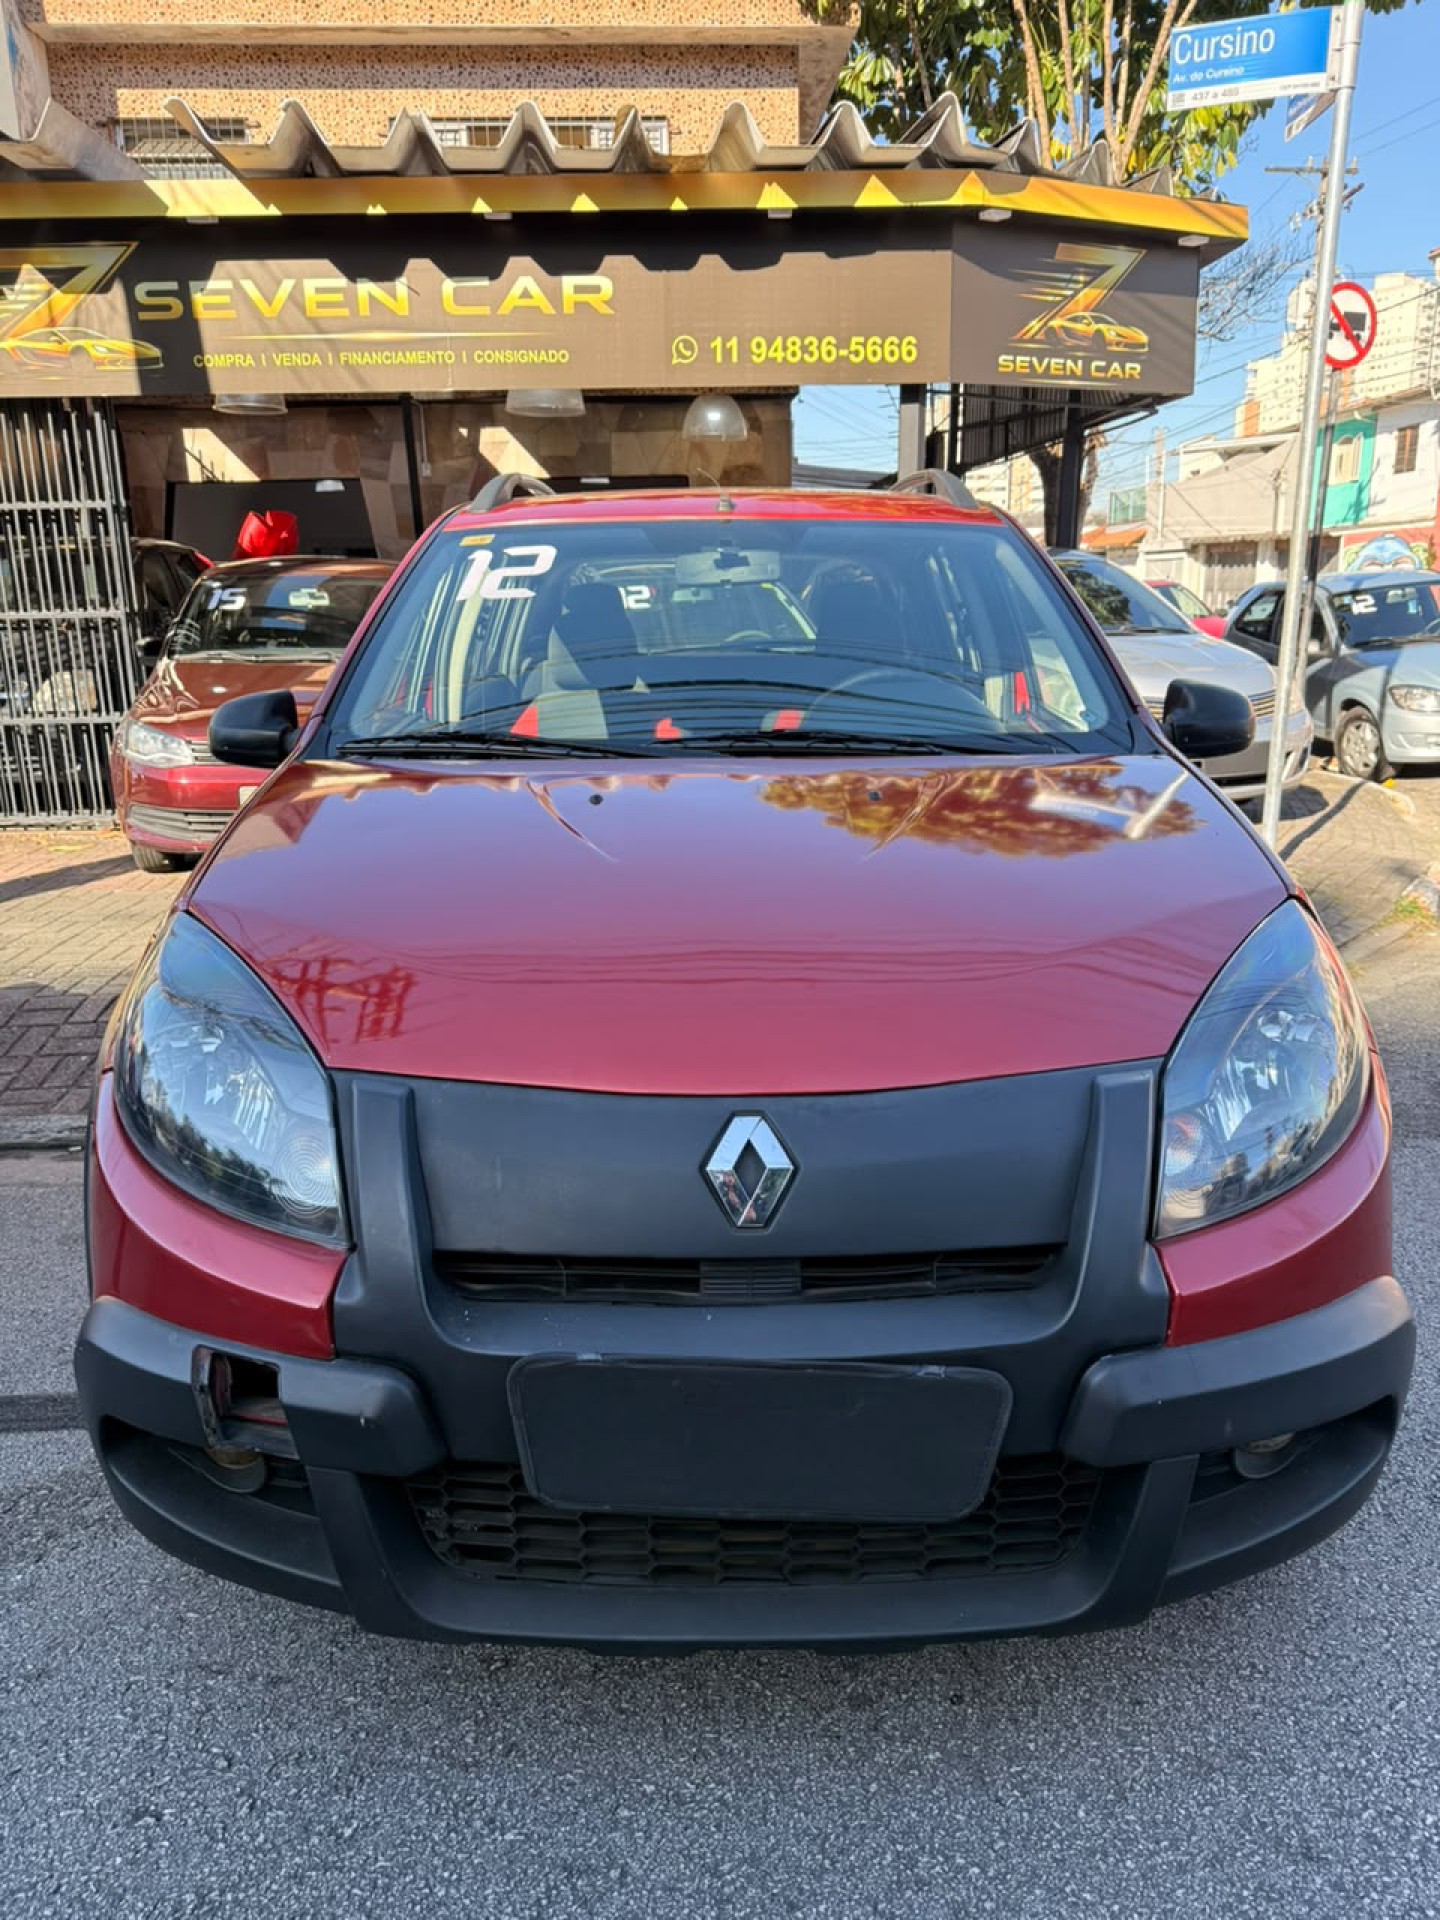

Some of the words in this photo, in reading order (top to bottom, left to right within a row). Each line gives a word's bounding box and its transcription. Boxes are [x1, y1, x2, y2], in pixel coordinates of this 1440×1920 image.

[1174, 26, 1276, 65] Cursino
[134, 277, 409, 320] SEVEN
[441, 275, 615, 316] CAR
[193, 353, 256, 368] COMPRA
[272, 352, 322, 367] VENDA
[338, 350, 456, 366] FINANCIAMENTO
[473, 348, 571, 364] CONSIGNADO
[710, 336, 739, 364] 11
[750, 335, 918, 364] 94836-5666
[998, 354, 1084, 376] SEVEN
[1090, 359, 1142, 380] CAR
[455, 545, 558, 601] 12
[206, 587, 247, 610] 15
[618, 585, 652, 609] 12
